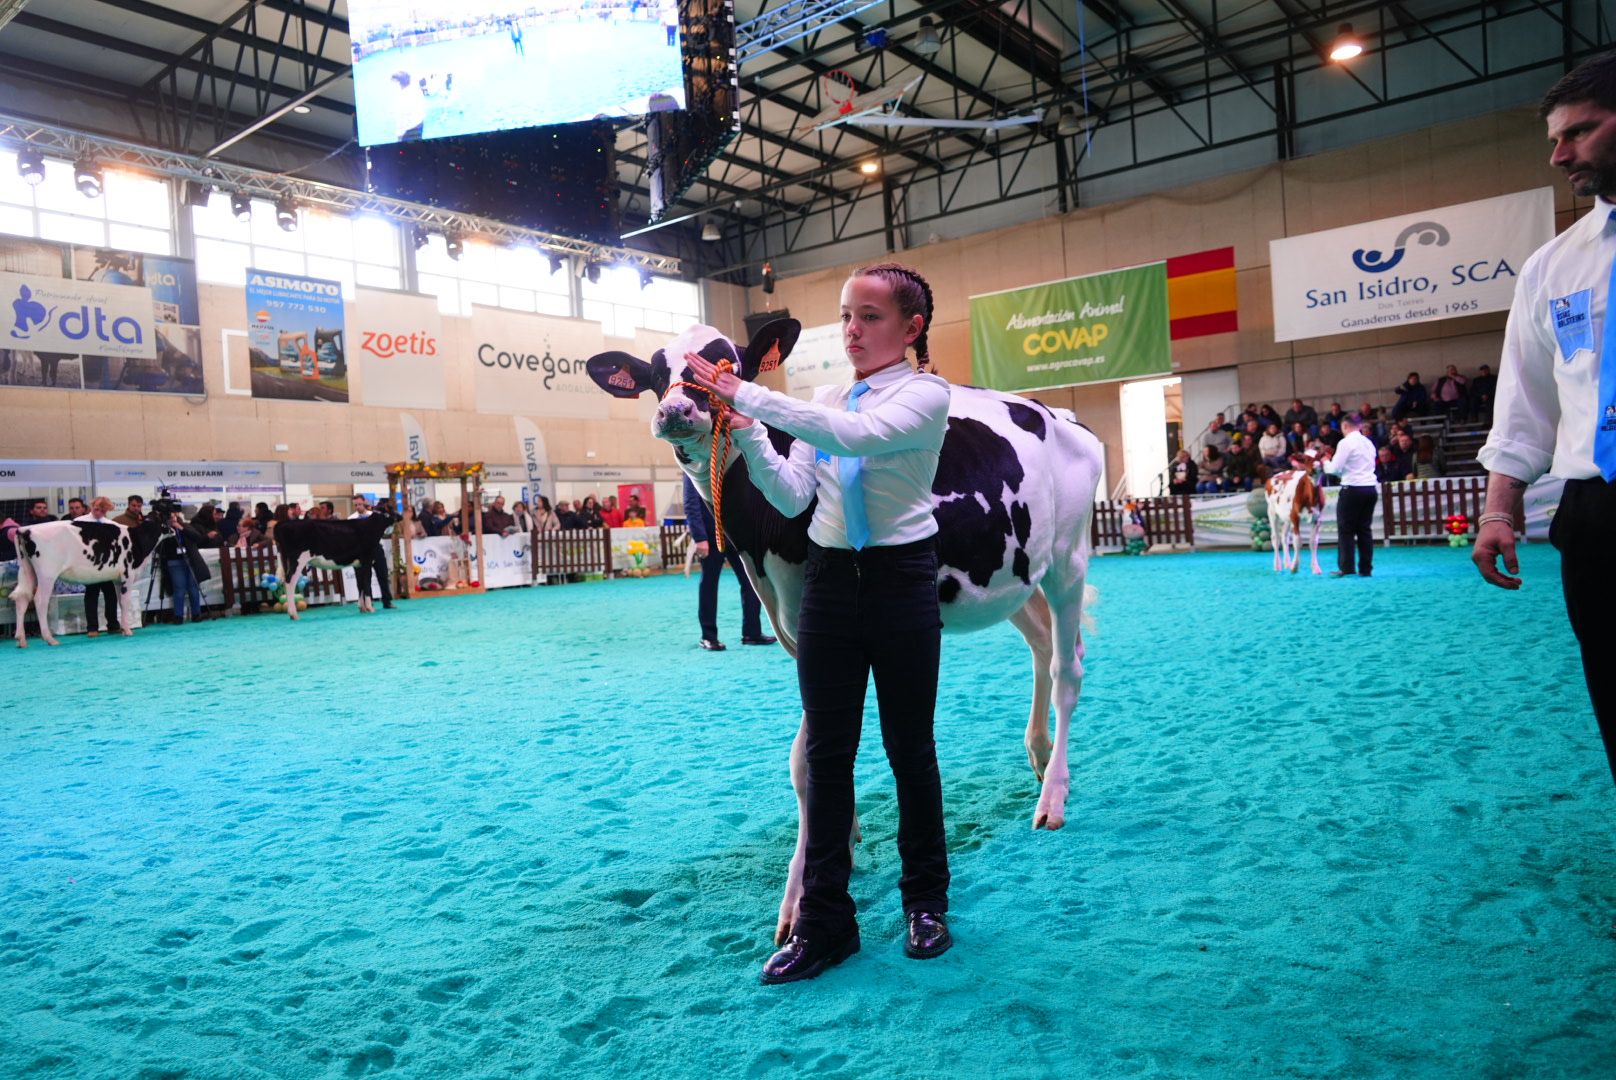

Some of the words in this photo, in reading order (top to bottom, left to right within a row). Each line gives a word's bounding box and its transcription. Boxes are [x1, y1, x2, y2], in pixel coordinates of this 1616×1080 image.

[249, 274, 340, 297] ASIMOTO
[1305, 288, 1347, 309] San
[1359, 276, 1438, 300] Isidro,
[1451, 259, 1516, 286] SCA
[58, 304, 143, 345] dta
[1006, 310, 1075, 331] Alimentación
[1079, 295, 1125, 319] Animal
[1341, 313, 1401, 328] Ganaderos
[1405, 306, 1438, 319] desde
[1445, 300, 1479, 313] 1965
[361, 331, 436, 358] zoetis
[1023, 323, 1108, 356] COVAP
[759, 359, 778, 372] 9251
